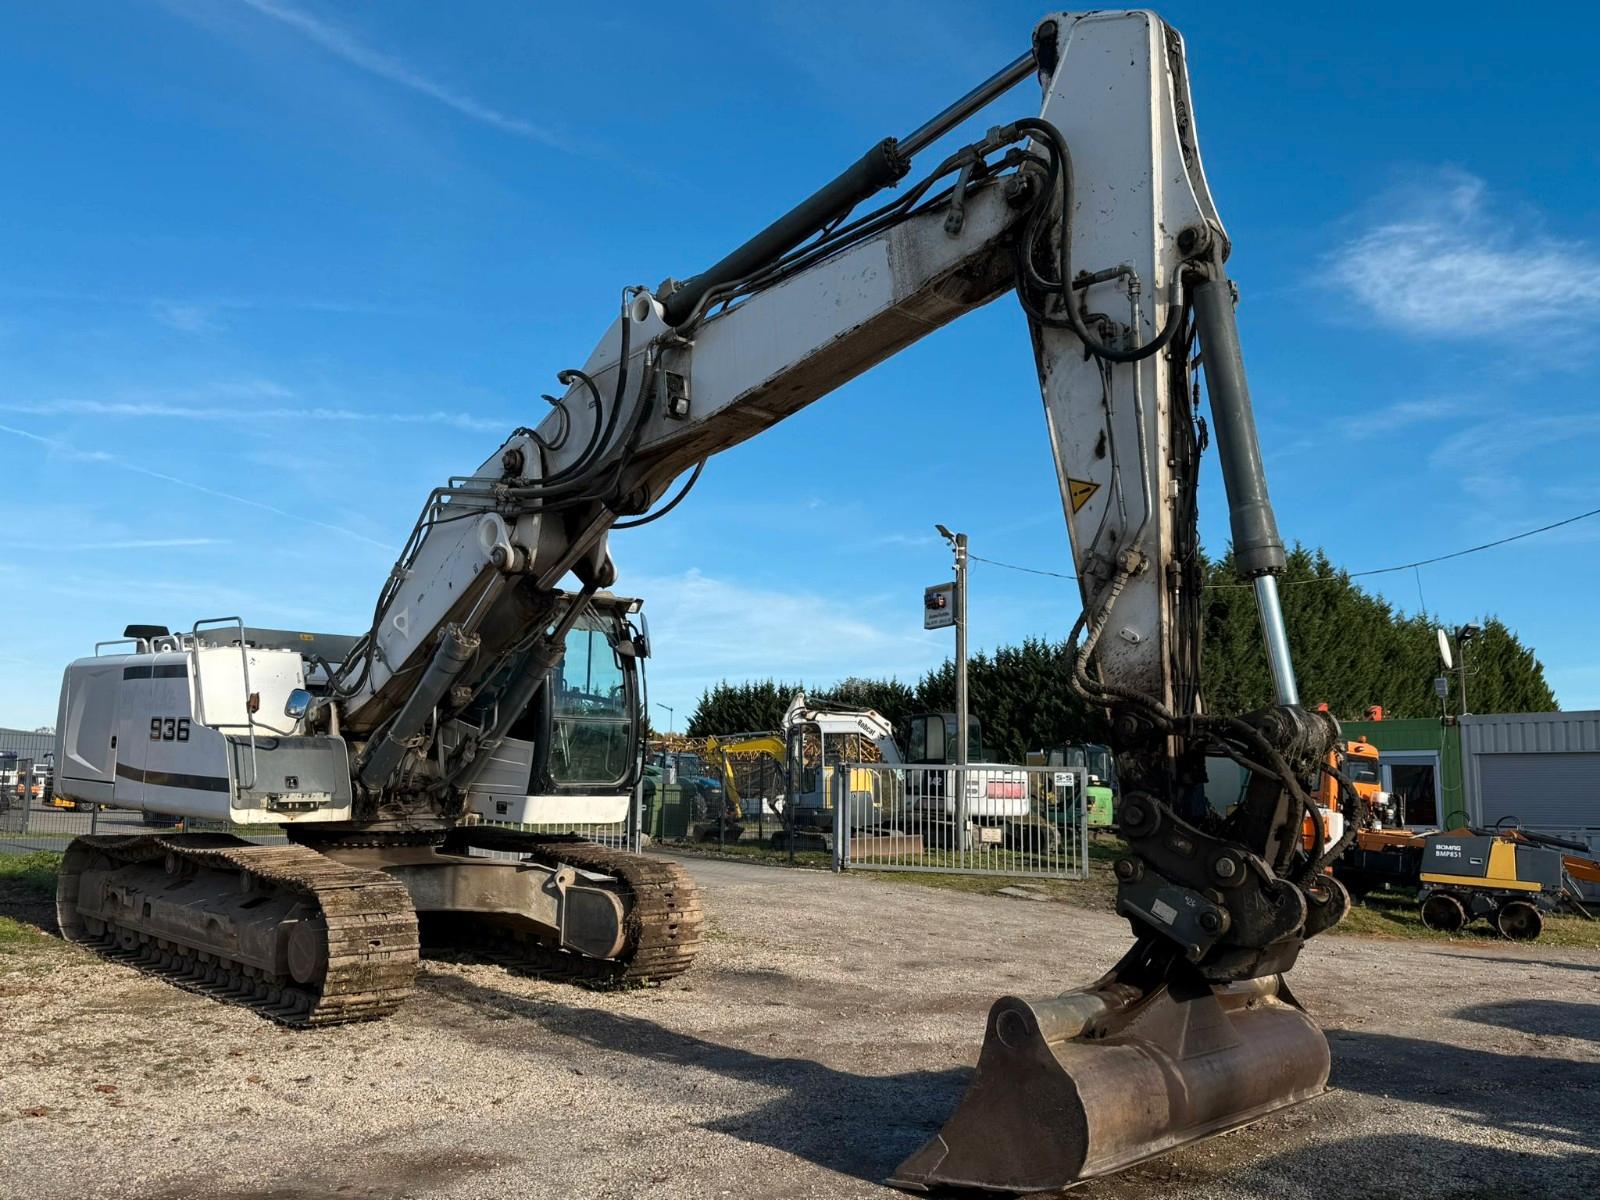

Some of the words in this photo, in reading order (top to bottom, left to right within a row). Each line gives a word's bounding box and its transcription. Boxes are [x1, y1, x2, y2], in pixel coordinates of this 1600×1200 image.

[150, 717, 190, 742] 936
[857, 719, 876, 736] Bobcat
[1435, 850, 1462, 858] BMP851
